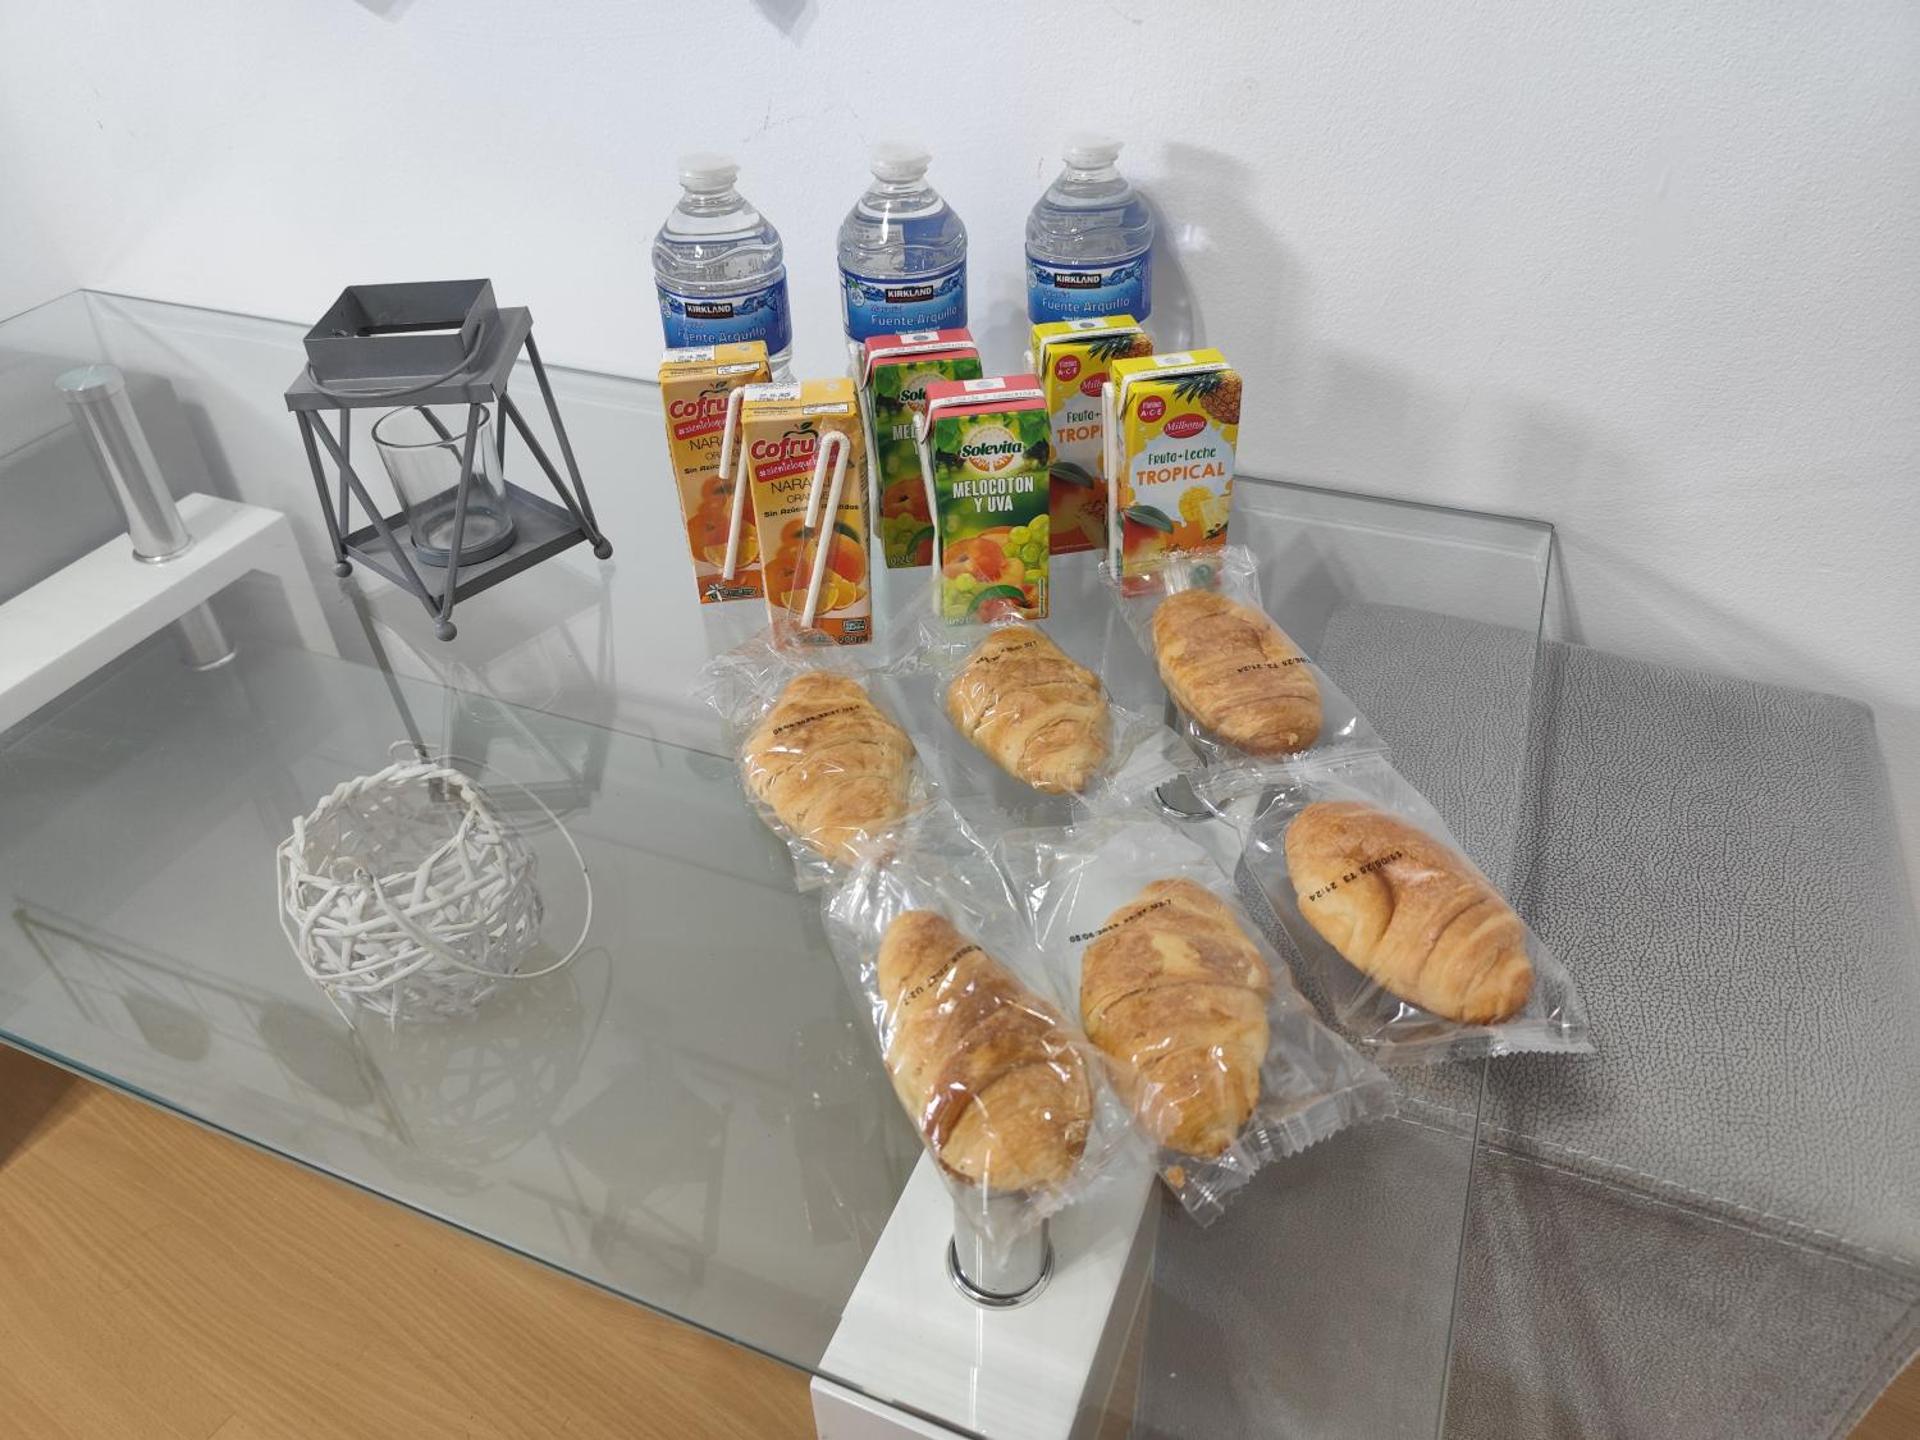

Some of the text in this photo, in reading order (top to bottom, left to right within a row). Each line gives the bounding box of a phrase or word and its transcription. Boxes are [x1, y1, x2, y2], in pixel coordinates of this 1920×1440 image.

[1056, 274, 1100, 284] KIRKLAND
[887, 285, 932, 298] KIRKLAND
[687, 303, 732, 314] KIRKLAND
[1042, 298, 1080, 312] Fuente
[871, 314, 914, 326] Fuente
[917, 306, 957, 325] Arquillo
[669, 397, 728, 418] Cofru
[1057, 425, 1103, 443] TROPI
[750, 437, 816, 460] Cofru
[961, 440, 1023, 458] Solevita
[1136, 462, 1225, 486] TROPICAL
[973, 495, 1014, 513] Y UVA
